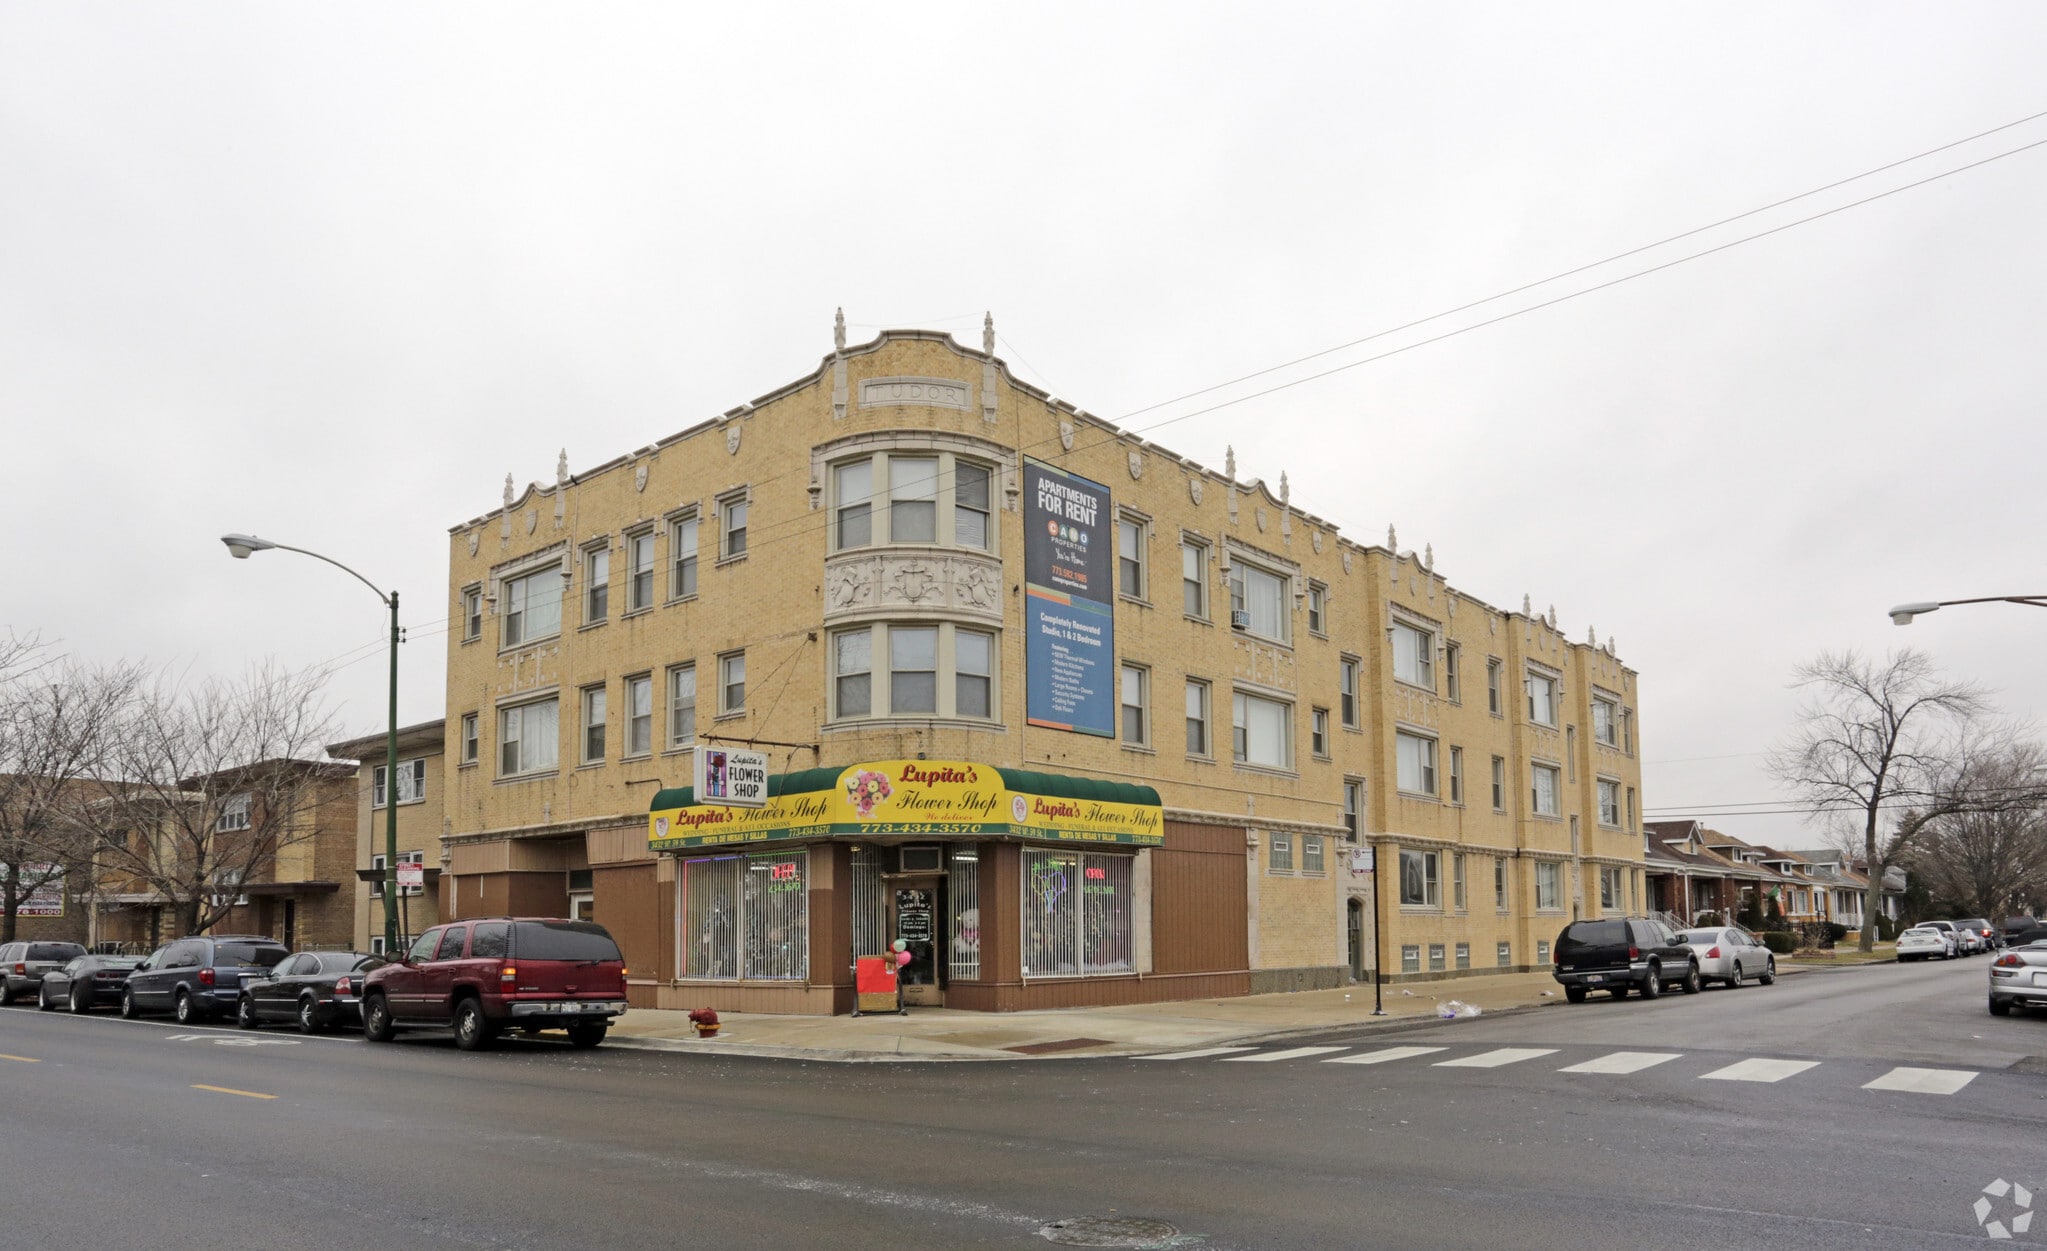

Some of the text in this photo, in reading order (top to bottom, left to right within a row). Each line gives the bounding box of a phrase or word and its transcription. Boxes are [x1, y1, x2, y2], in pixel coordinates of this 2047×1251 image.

[872, 385, 958, 402] TUDOR
[1038, 477, 1097, 510] APARTMENTS
[1038, 490, 1097, 527] FOR RENT
[1050, 535, 1087, 553] PROPERTIES
[1040, 612, 1101, 635] Completely Renovated
[1042, 624, 1061, 638] Studio,
[1066, 630, 1072, 640] &
[1072, 632, 1077, 641] 2
[1077, 633, 1101, 647] Bedroom
[729, 766, 764, 783] FLOWER
[899, 764, 978, 788] Lupita's
[734, 782, 760, 798] SHOP
[676, 798, 827, 829] Lupita's Flower Shop
[897, 790, 999, 817] Flower Shop
[941, 812, 974, 821] deliver
[1033, 797, 1158, 834] Lupita's Flower Shop
[788, 824, 831, 837] 773-434-3570
[860, 823, 982, 833] 773-434-3570
